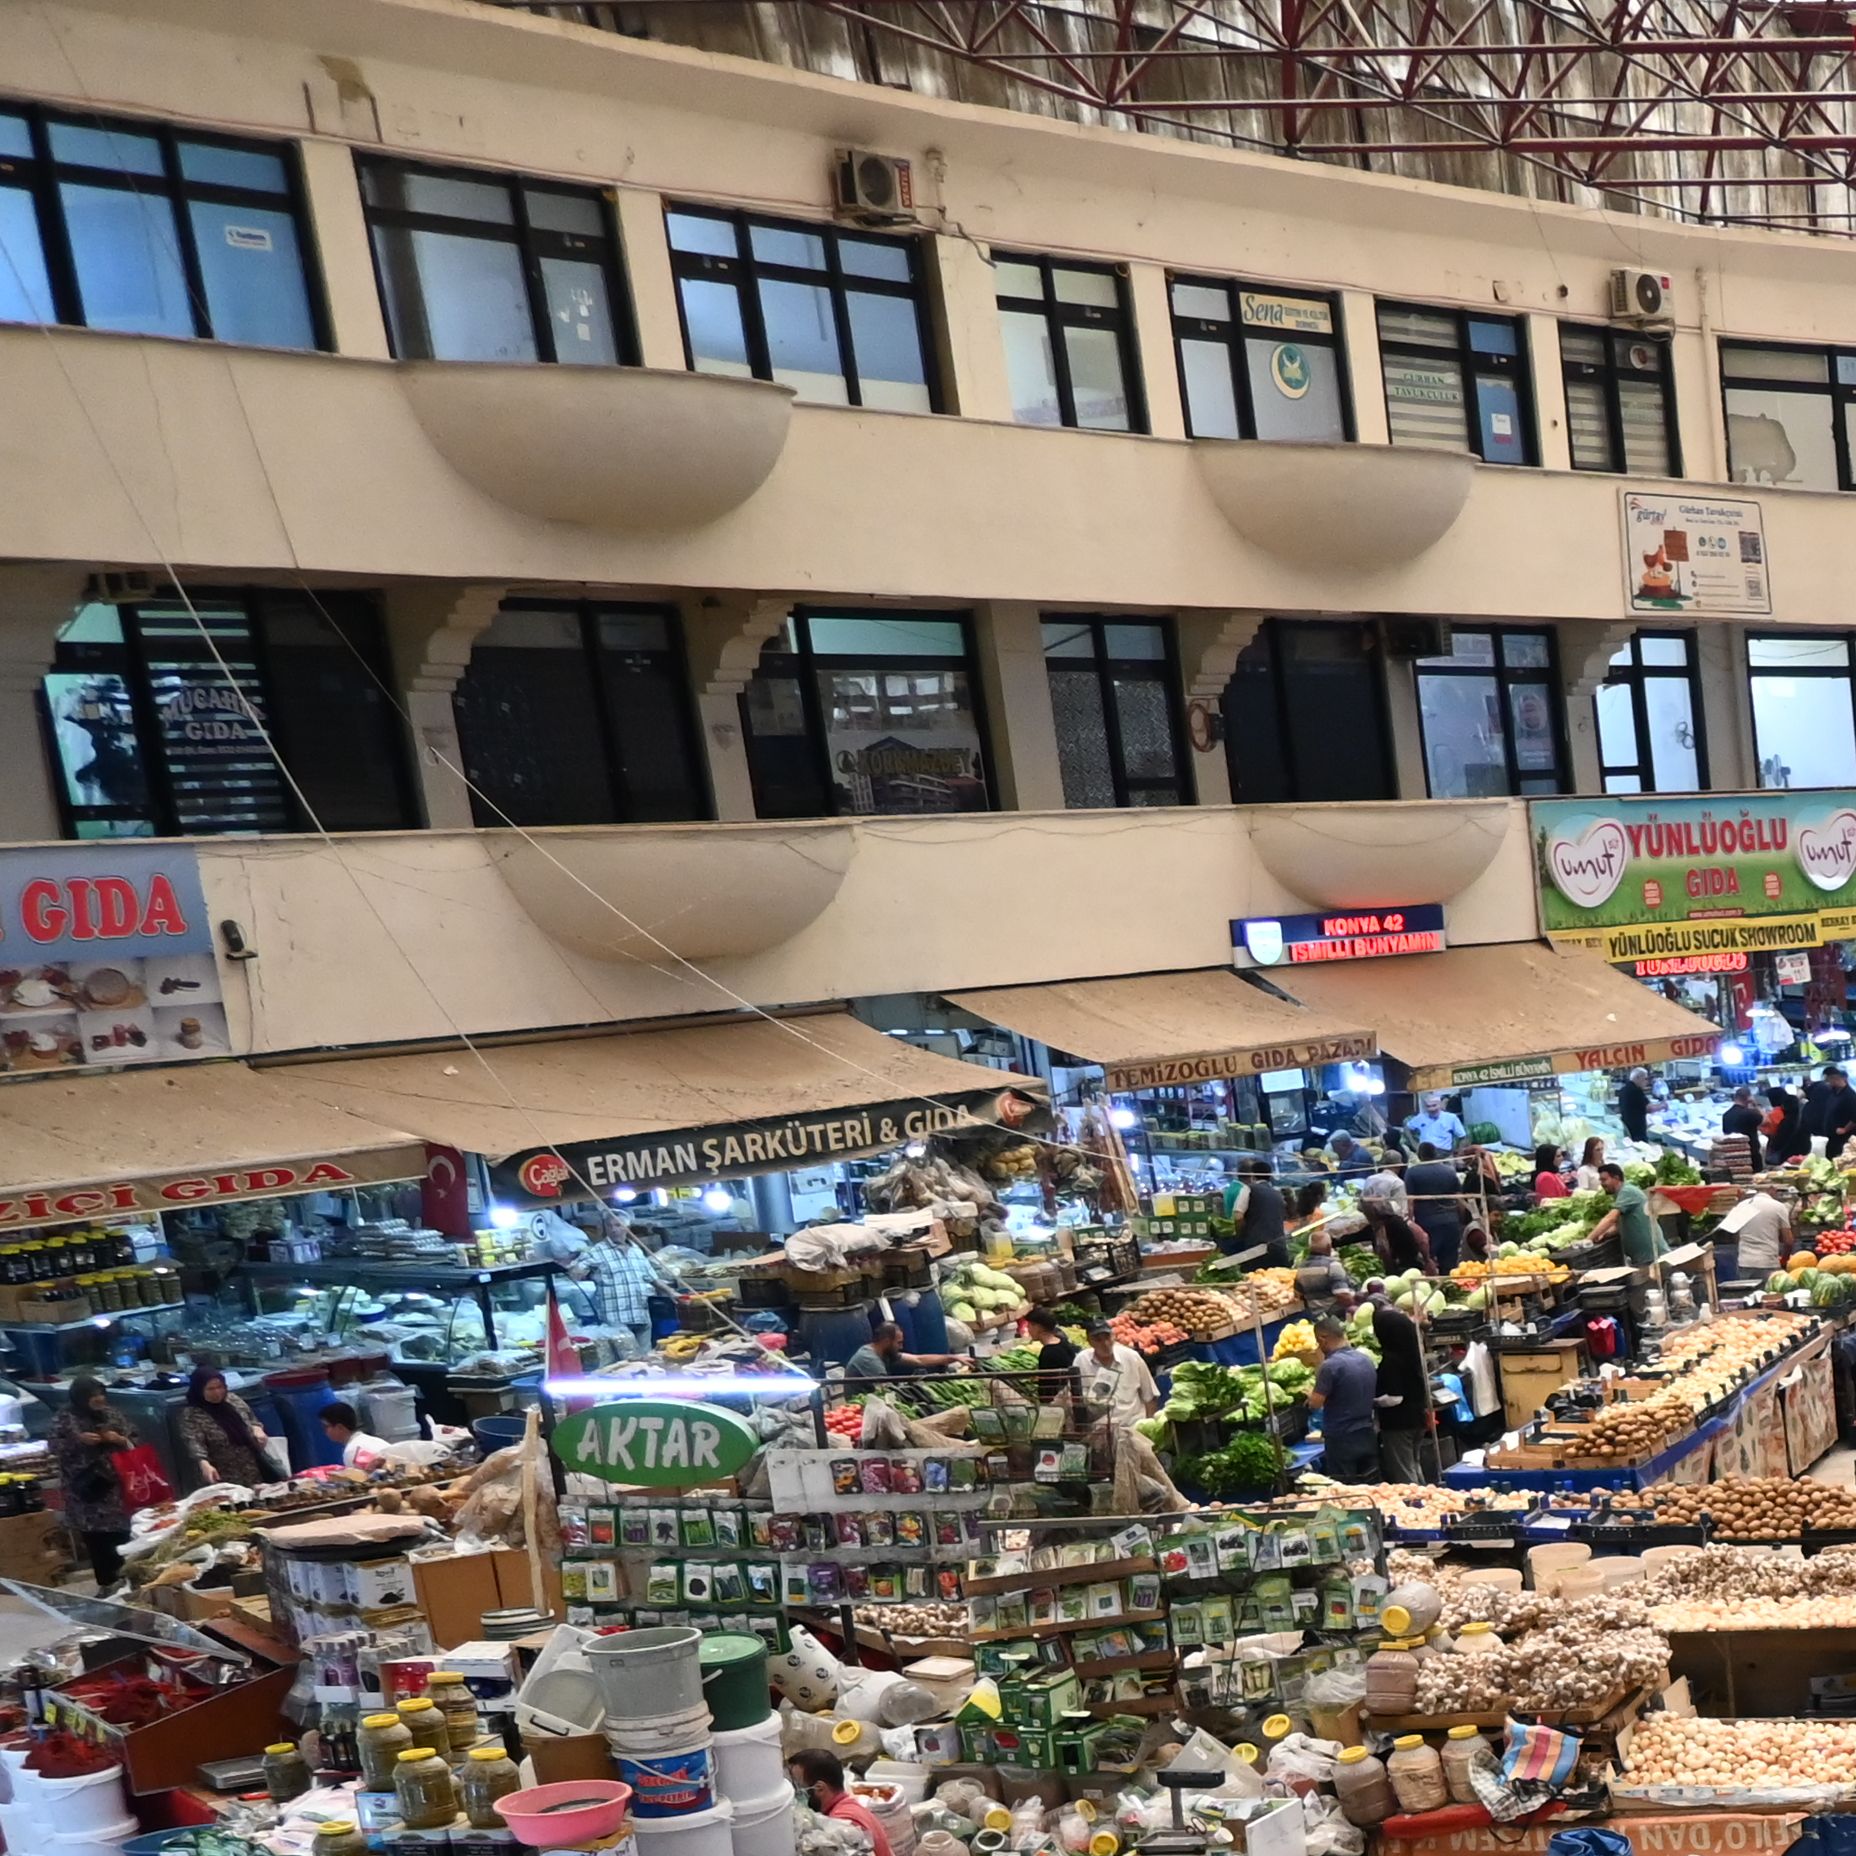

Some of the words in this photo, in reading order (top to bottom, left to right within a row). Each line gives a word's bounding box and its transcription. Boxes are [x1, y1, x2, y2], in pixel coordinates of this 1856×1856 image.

[185, 722, 248, 740] GIDA
[1626, 809, 1789, 858] YÜNLÜOĞLU
[1806, 829, 1852, 866] umut
[1560, 838, 1616, 880] umut
[1686, 868, 1741, 898] GIDA
[20, 873, 189, 944] GIDA
[1324, 915, 1381, 937] KONYA
[1383, 913, 1404, 931] 42
[1608, 926, 1692, 958] YÜNLÜOĞLU
[1693, 925, 1739, 949] SUCUK
[1738, 922, 1817, 948] SHOWROOM
[1110, 1054, 1238, 1089] TEMİZOĞLU
[1250, 1049, 1299, 1070] GIDA
[587, 1142, 698, 1187] ERMAN
[702, 1111, 873, 1175] ŞARKÜTERİ
[880, 1115, 898, 1142] &
[904, 1103, 971, 1140] GIDA
[161, 1162, 354, 1201] GIDA
[577, 1415, 721, 1470] AKTAR
